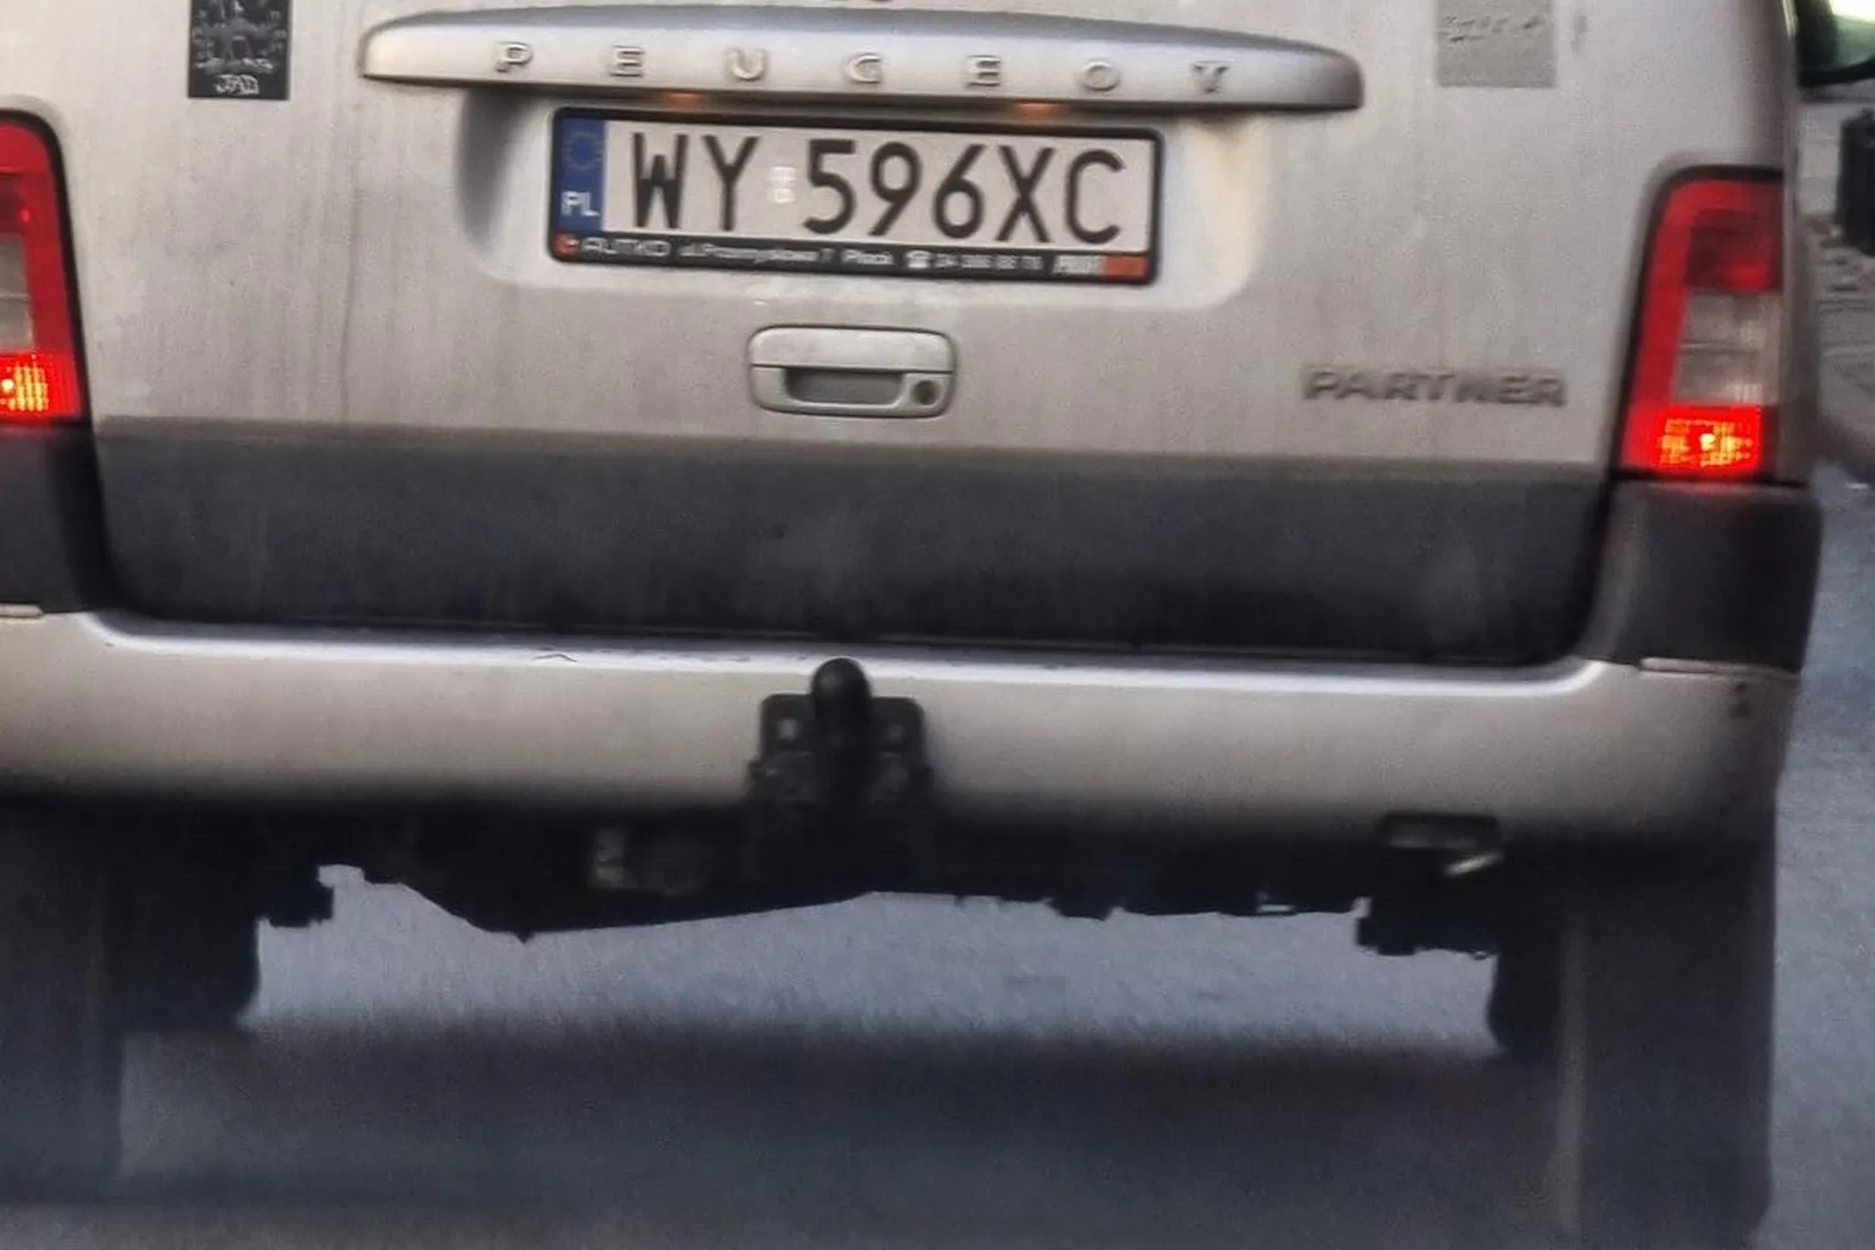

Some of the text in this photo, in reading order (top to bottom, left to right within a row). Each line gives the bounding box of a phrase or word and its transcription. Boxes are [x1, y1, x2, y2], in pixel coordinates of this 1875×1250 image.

[496, 40, 1234, 94] PEUGEOT
[561, 190, 600, 217] PL
[632, 131, 1125, 244] WY 596XC
[1303, 367, 1567, 408] PARTNER
